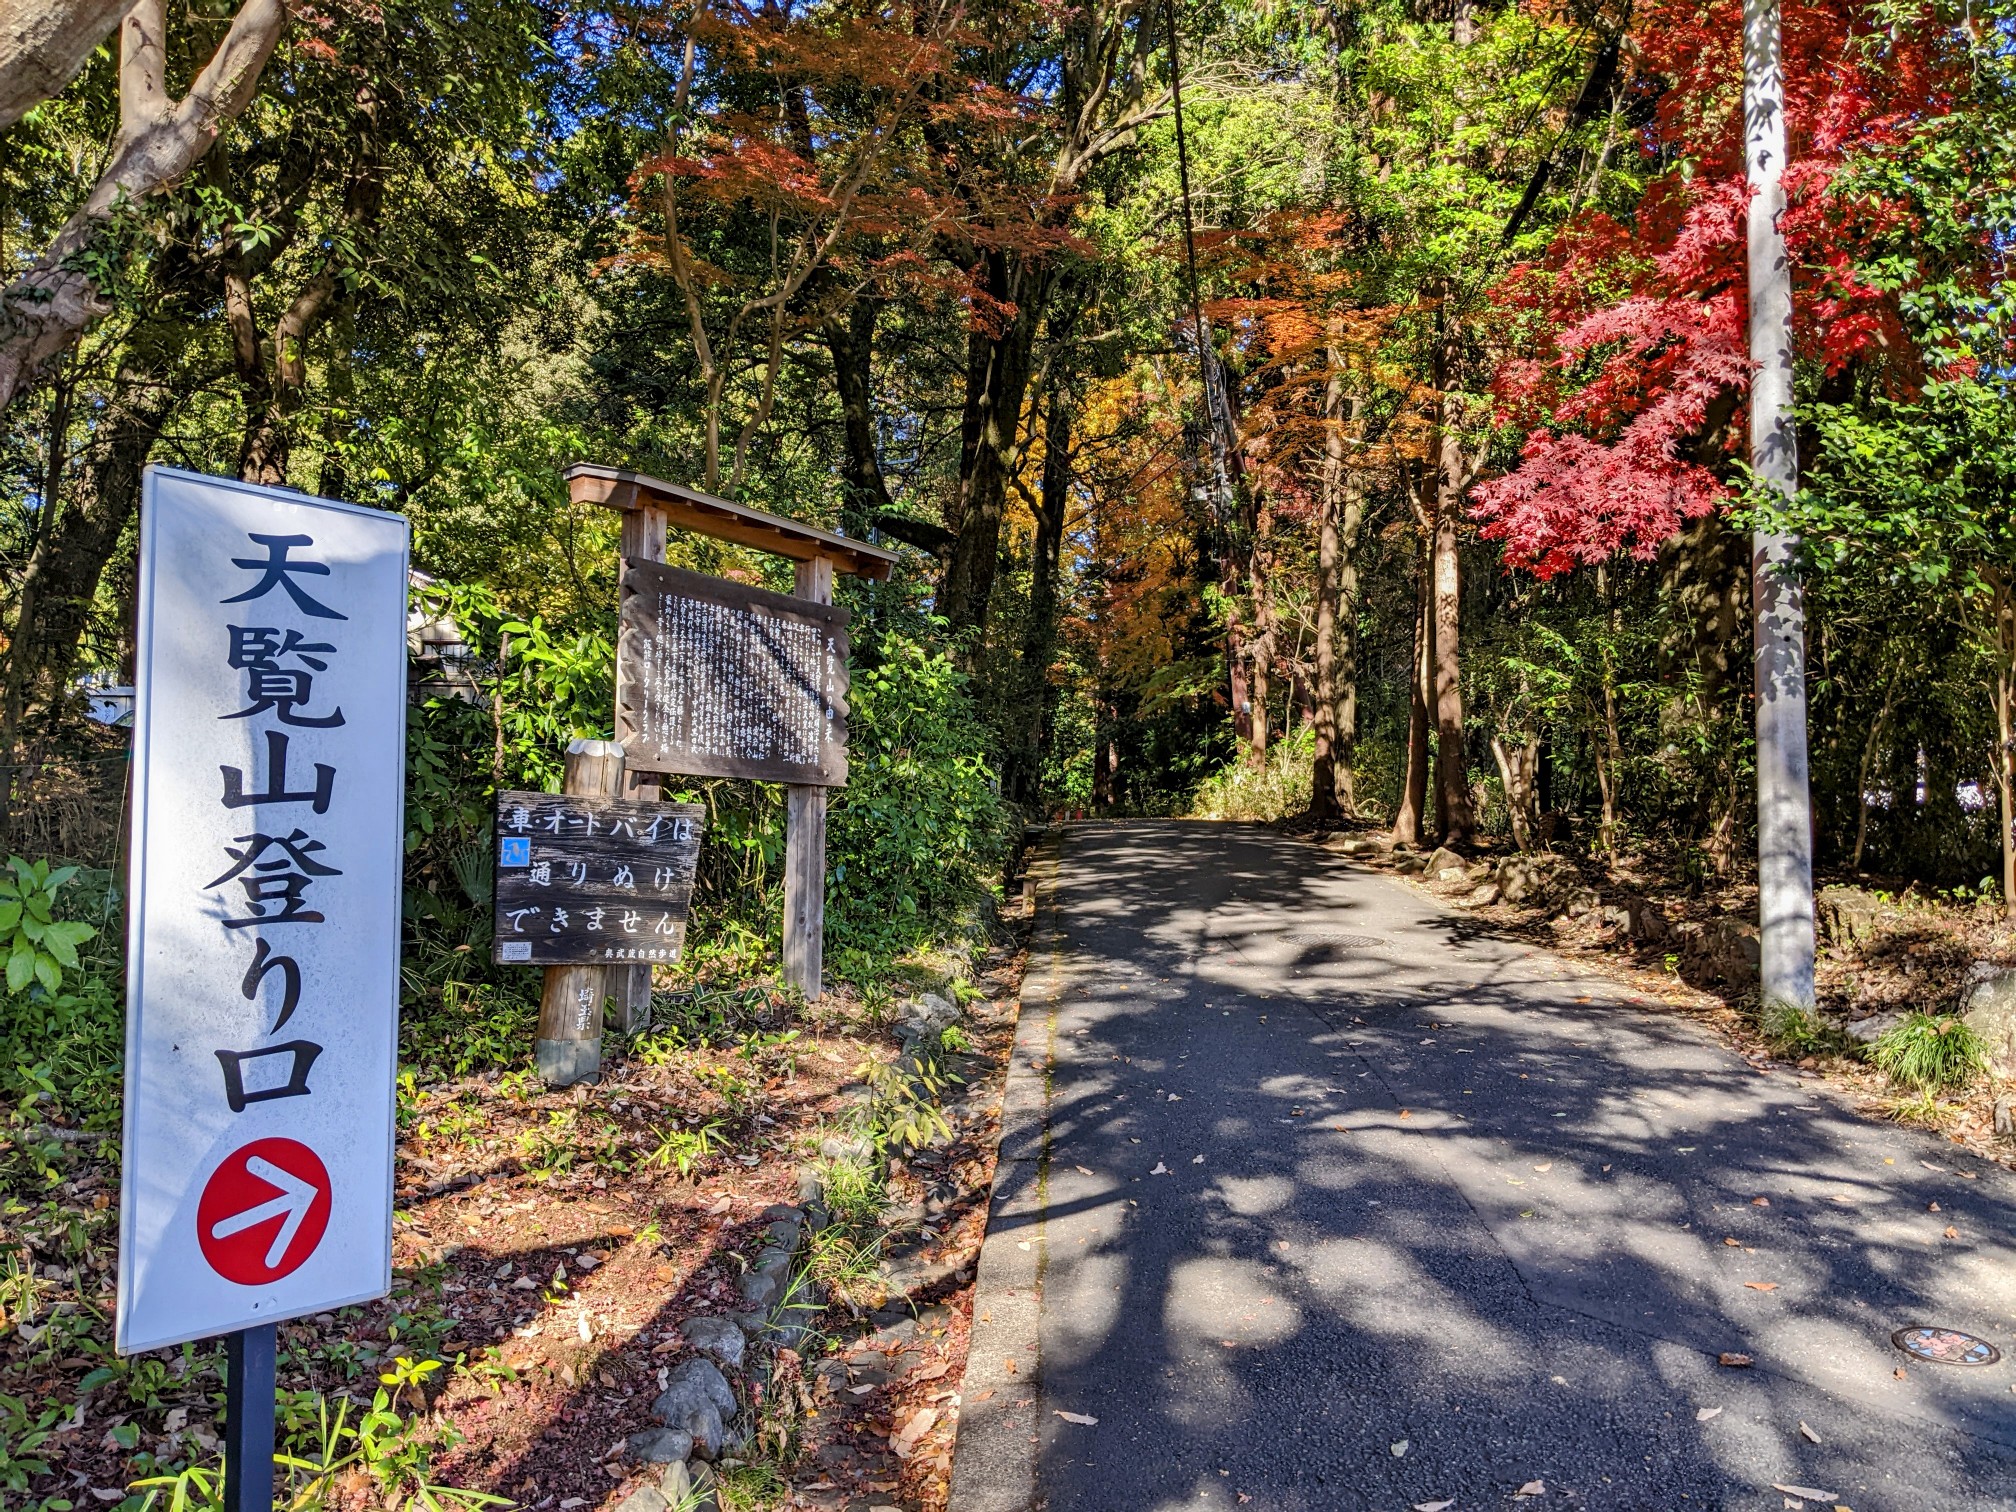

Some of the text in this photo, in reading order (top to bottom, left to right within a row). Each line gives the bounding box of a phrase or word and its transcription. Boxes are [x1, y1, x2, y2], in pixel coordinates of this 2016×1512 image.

[642, 638, 652, 742] 飯能ロータリークラブ
[824, 636, 836, 741] 天覧山の由来
[203, 532, 347, 1112] 天覧山登り口
[529, 861, 675, 891] 通りぬけ
[506, 906, 675, 935] できません
[604, 948, 677, 959] 奥武蔵自然歩道
[576, 986, 595, 1031] 埼玉県
